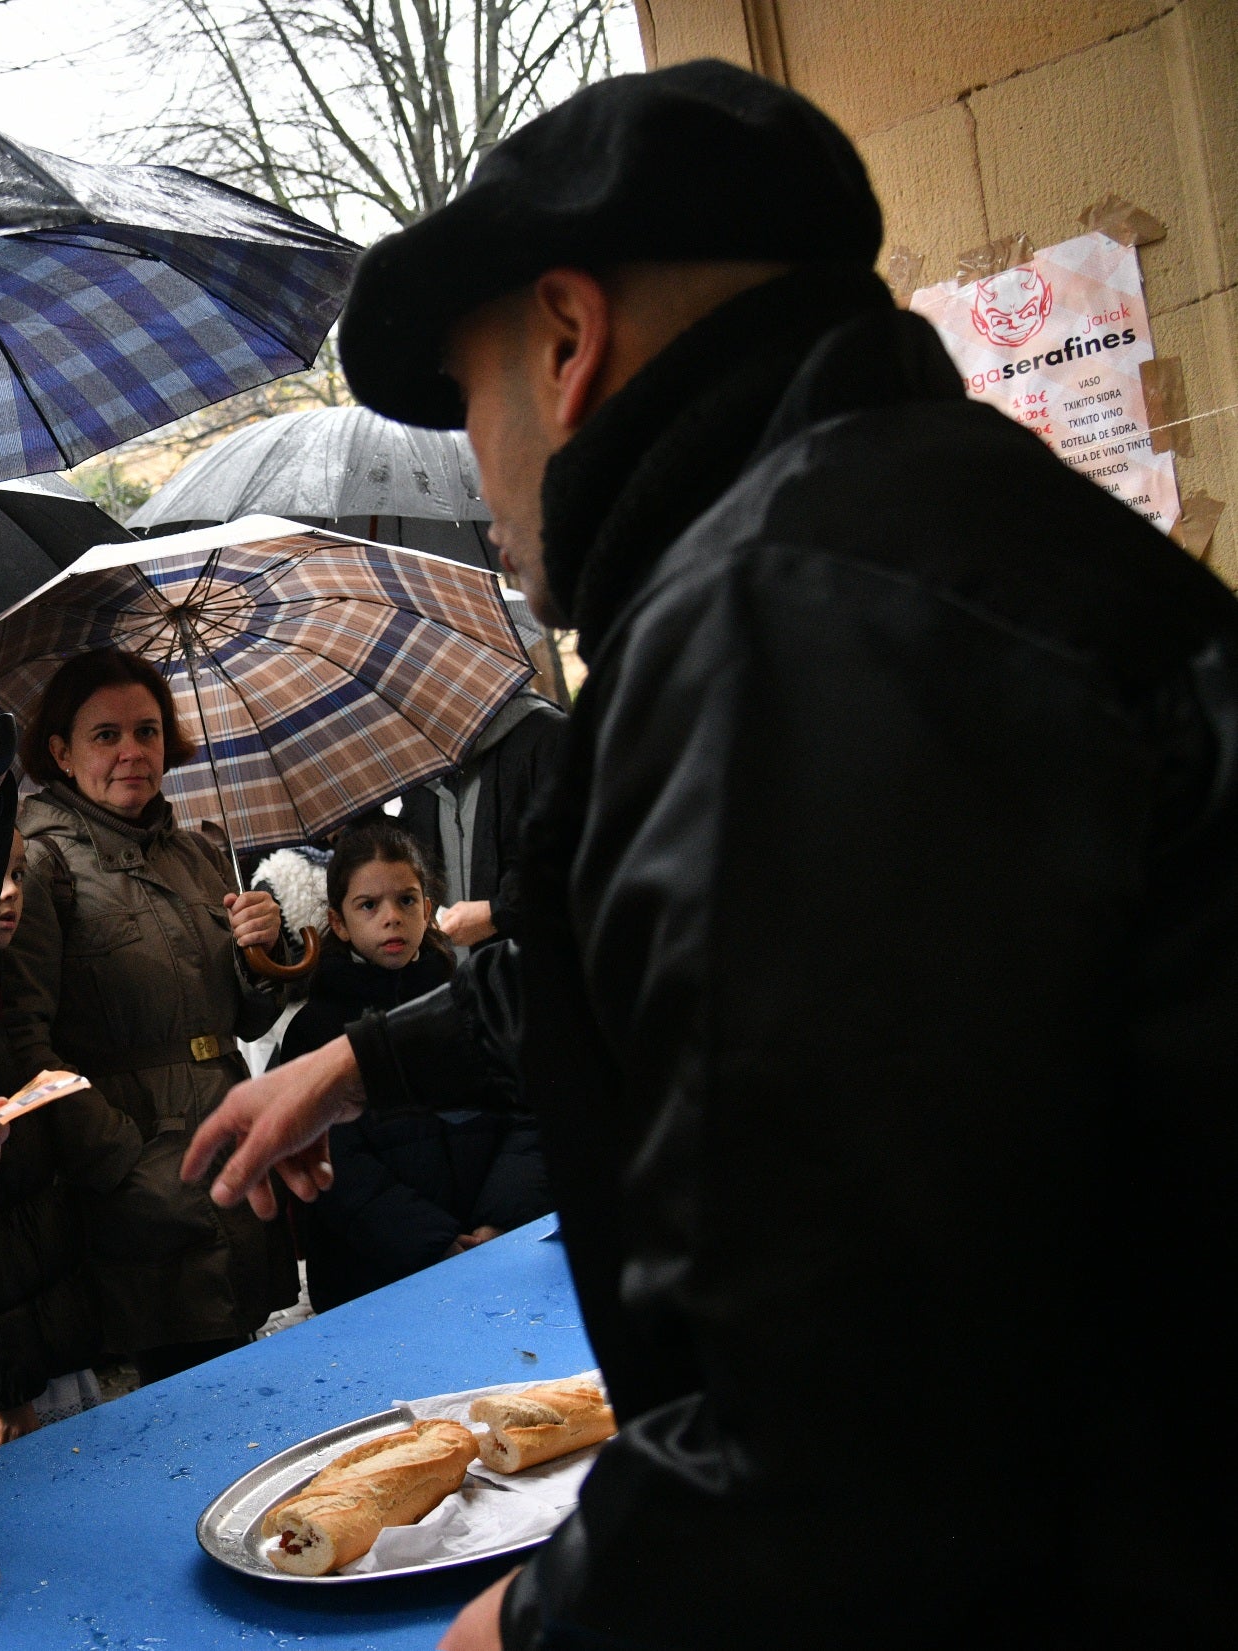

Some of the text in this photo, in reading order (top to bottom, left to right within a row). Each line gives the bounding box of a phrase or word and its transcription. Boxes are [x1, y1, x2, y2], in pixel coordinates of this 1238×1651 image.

[1083, 303, 1131, 334] jaiak
[1078, 376, 1101, 389] VASO
[1063, 388, 1122, 412] TXIKITO SIDRA
[1068, 407, 1123, 429] TXIKITO VINO
[1061, 432, 1097, 449] BOTELLA
[1098, 430, 1110, 440] DE
[1111, 422, 1138, 436] SIDRA
[1063, 437, 1153, 466] TELLA DE VINO TINTO
